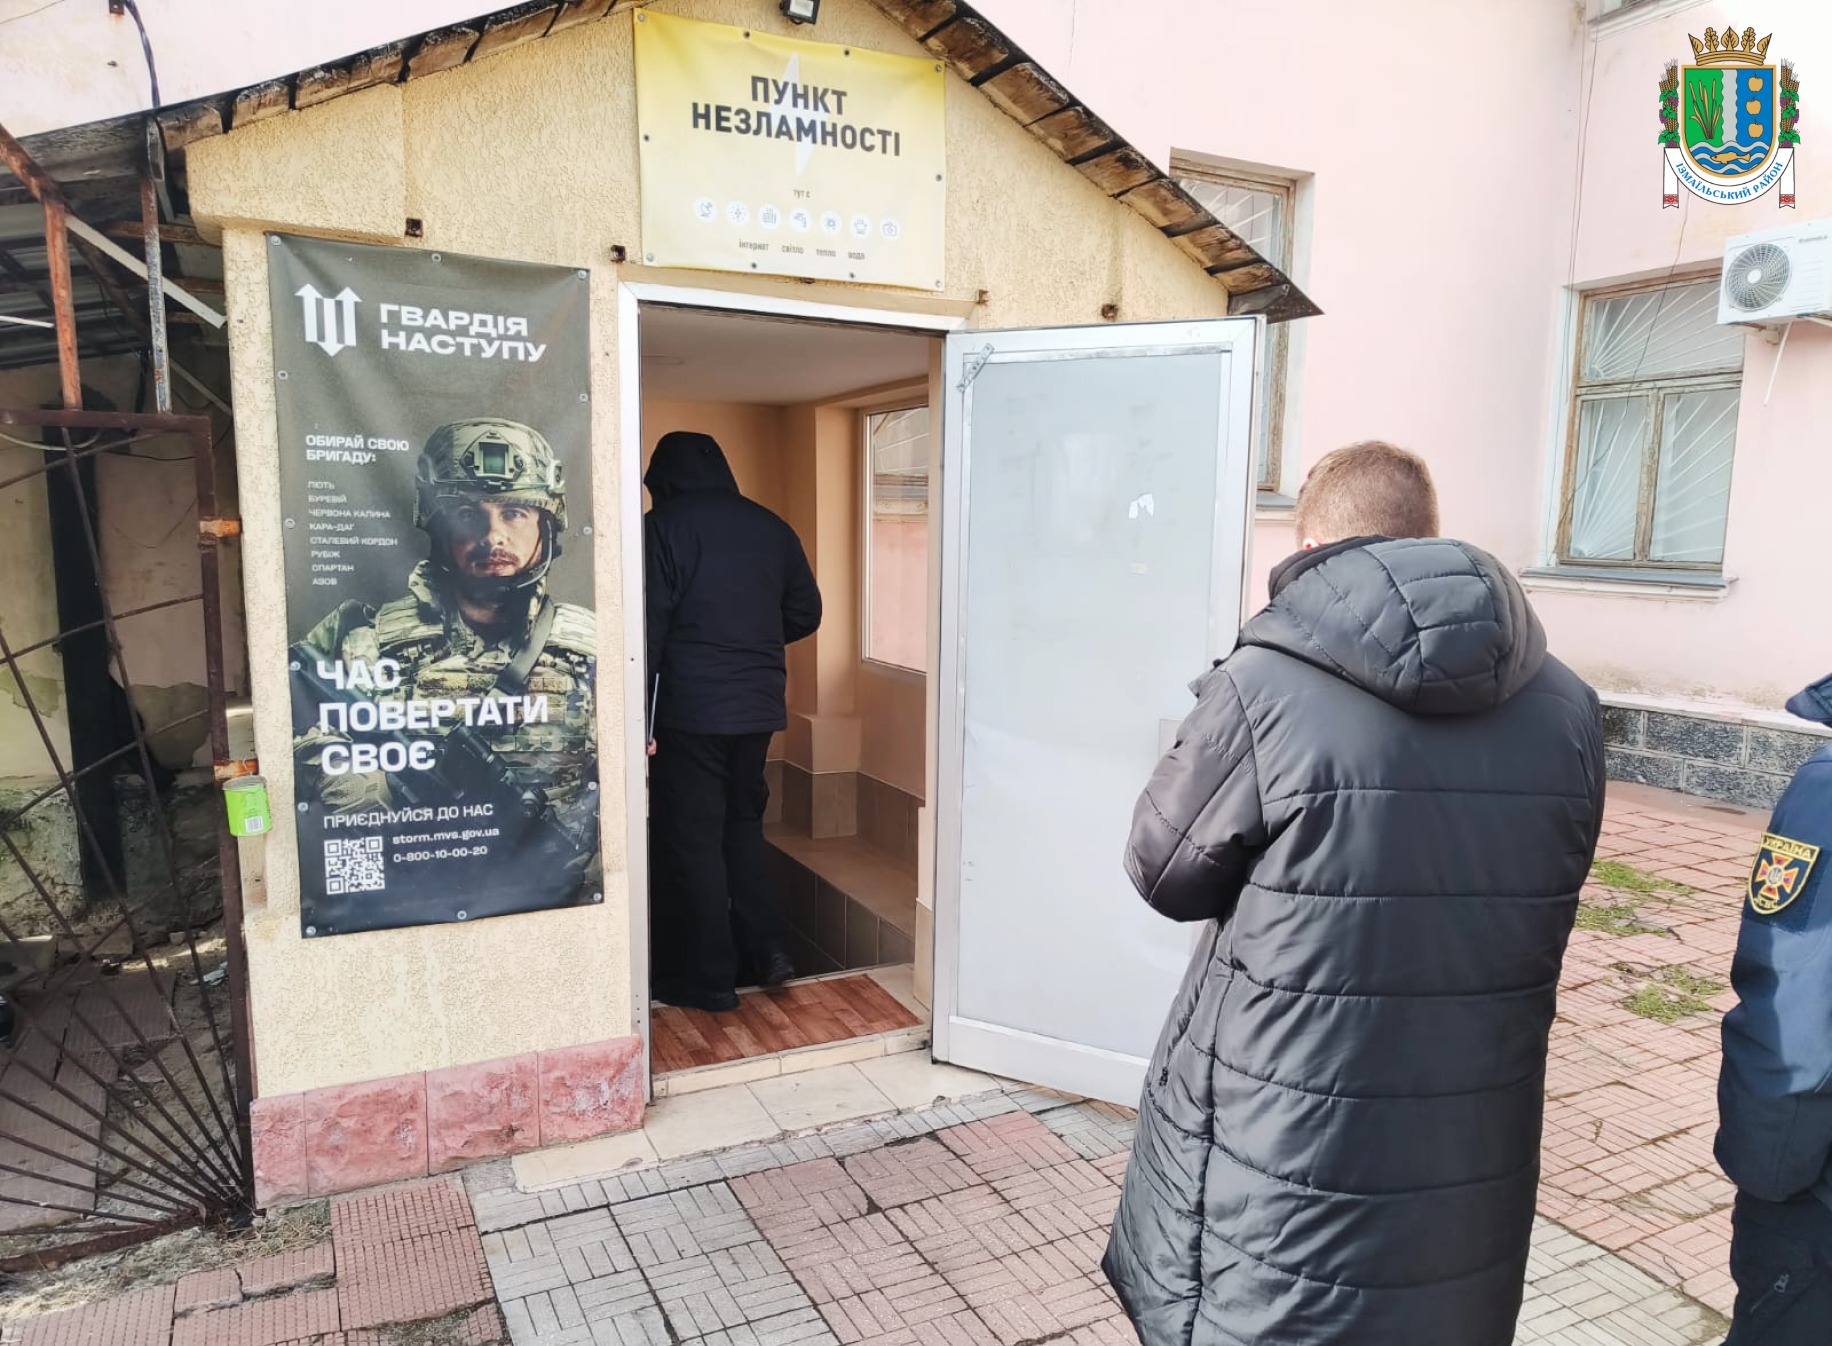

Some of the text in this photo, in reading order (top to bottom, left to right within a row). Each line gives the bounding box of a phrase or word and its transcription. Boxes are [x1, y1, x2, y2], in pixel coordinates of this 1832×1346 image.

[751, 75, 848, 115] ПУНКТ
[692, 102, 900, 156] НЕЗЛАМНОСТІ
[793, 189, 805, 199] тут
[739, 238, 769, 251] інтернет
[781, 244, 804, 254] світло
[816, 248, 836, 257] тепло
[379, 303, 528, 337] ГВАРДІЯ
[380, 329, 547, 363] НАСТУПУ
[306, 434, 410, 451] ОБИРАЙ СВОЮ
[306, 449, 376, 465] БРИГАДУ:
[308, 508, 391, 519] ЧЕРВОНА КАЛИНА
[309, 523, 355, 532] КАРА-ДАГ
[310, 536, 398, 546] СТАЛЕВИЙ КОРДОН
[311, 564, 355, 572] СПАРТАН
[312, 577, 338, 586] АЗОВ
[316, 659, 401, 690] ЧАС
[318, 695, 549, 733] ПОВЕРТАТИ
[320, 740, 436, 776] СВОЄ
[323, 804, 494, 829] ПРИЄДНУЙСЯ ДО НАС
[392, 827, 500, 845] storm.mvs.gov.ua
[393, 846, 488, 863] 0-800-10-00-20
